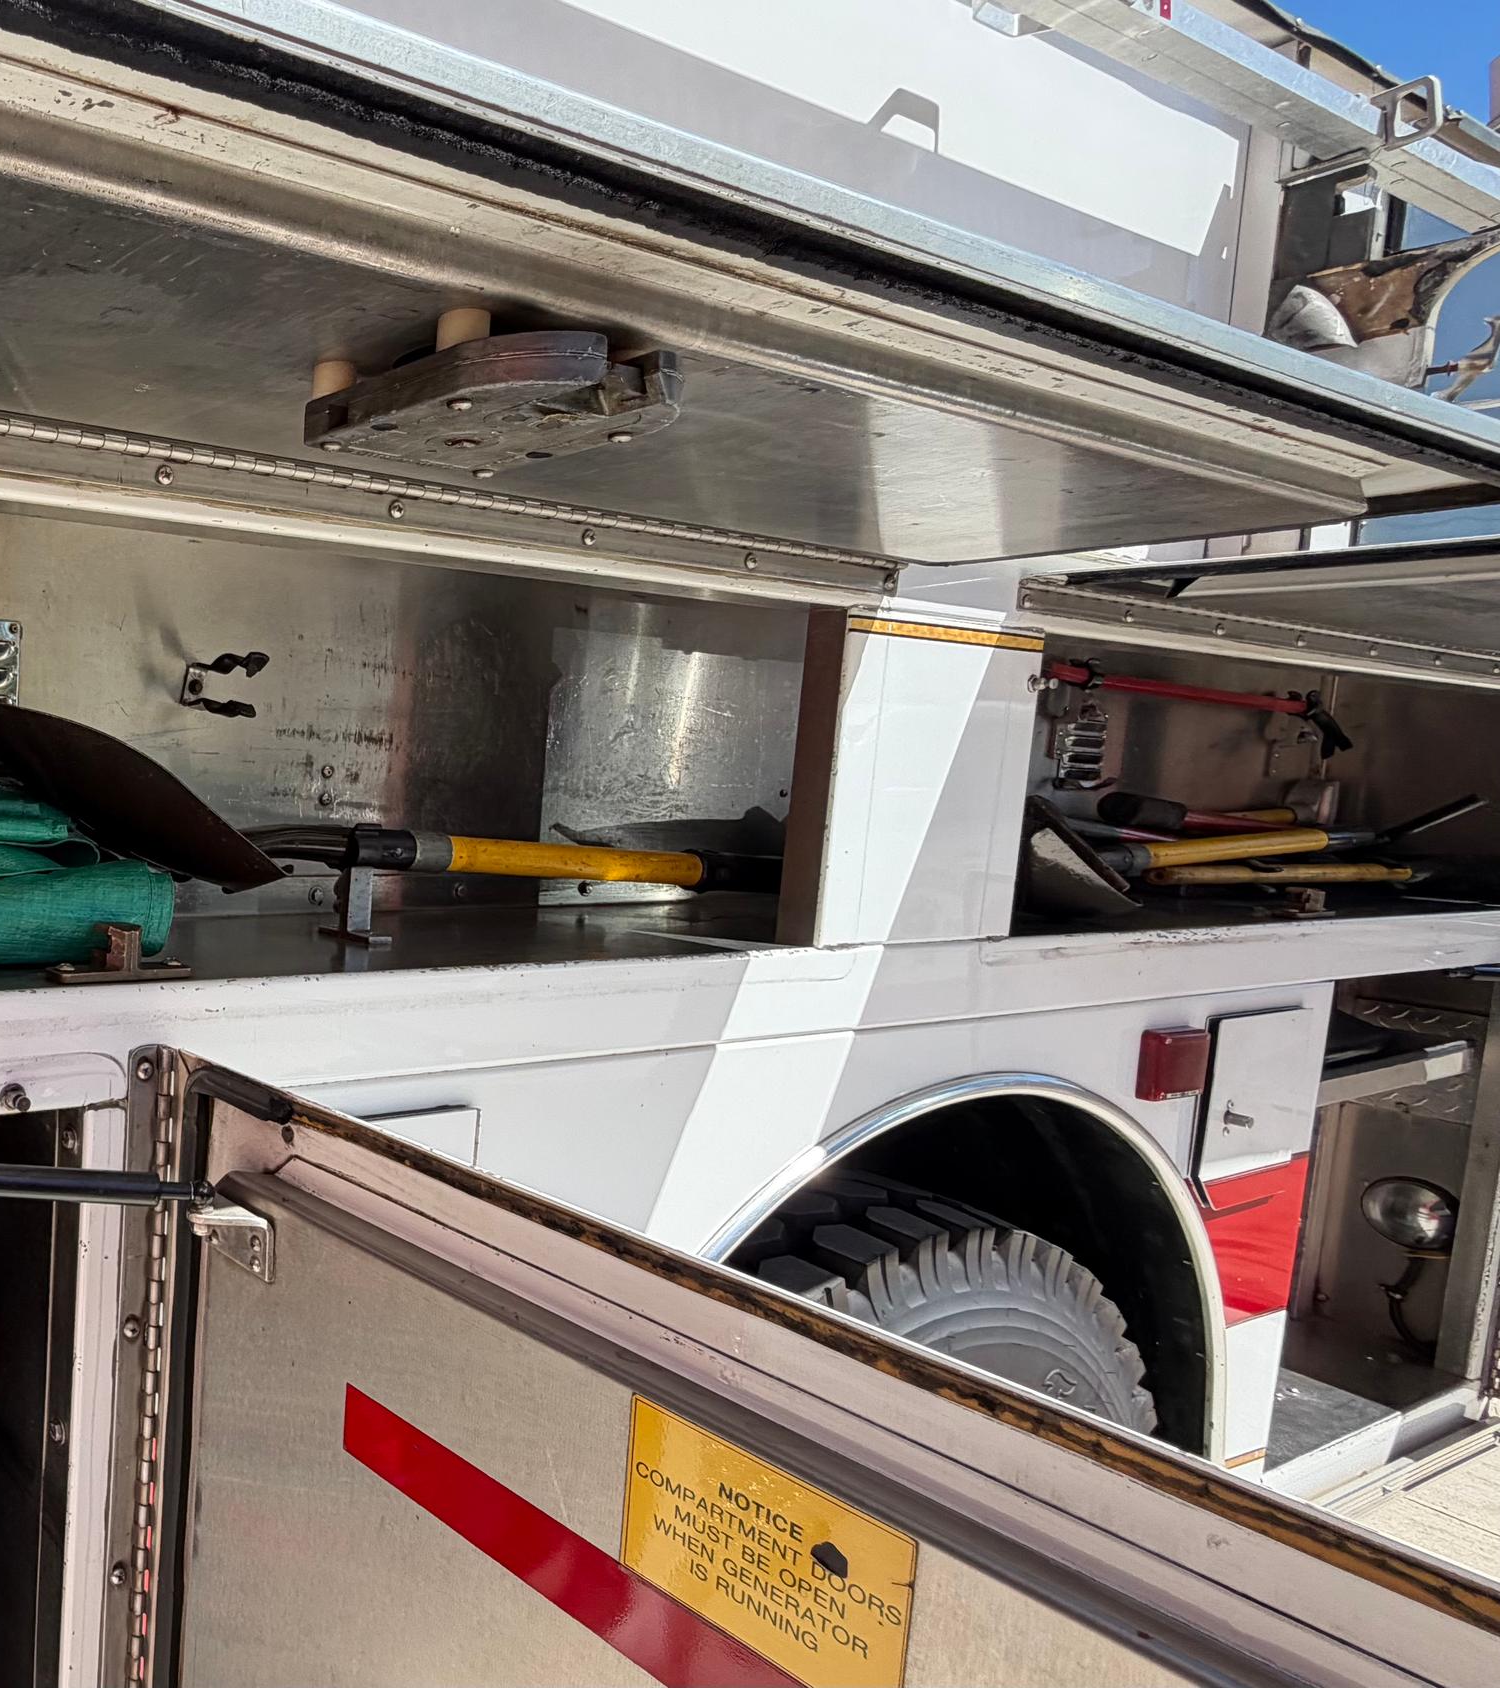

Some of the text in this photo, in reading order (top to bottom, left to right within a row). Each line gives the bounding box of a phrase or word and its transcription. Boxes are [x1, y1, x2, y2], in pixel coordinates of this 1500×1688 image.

[635, 1461, 902, 1627] COMPARTMENT DOORS
[674, 1505, 845, 1620] MUST BE OPEN
[718, 1482, 803, 1543] NOTICE
[653, 1514, 869, 1660] WHEN GENERATOR
[690, 1559, 819, 1653] IS RUNNING
